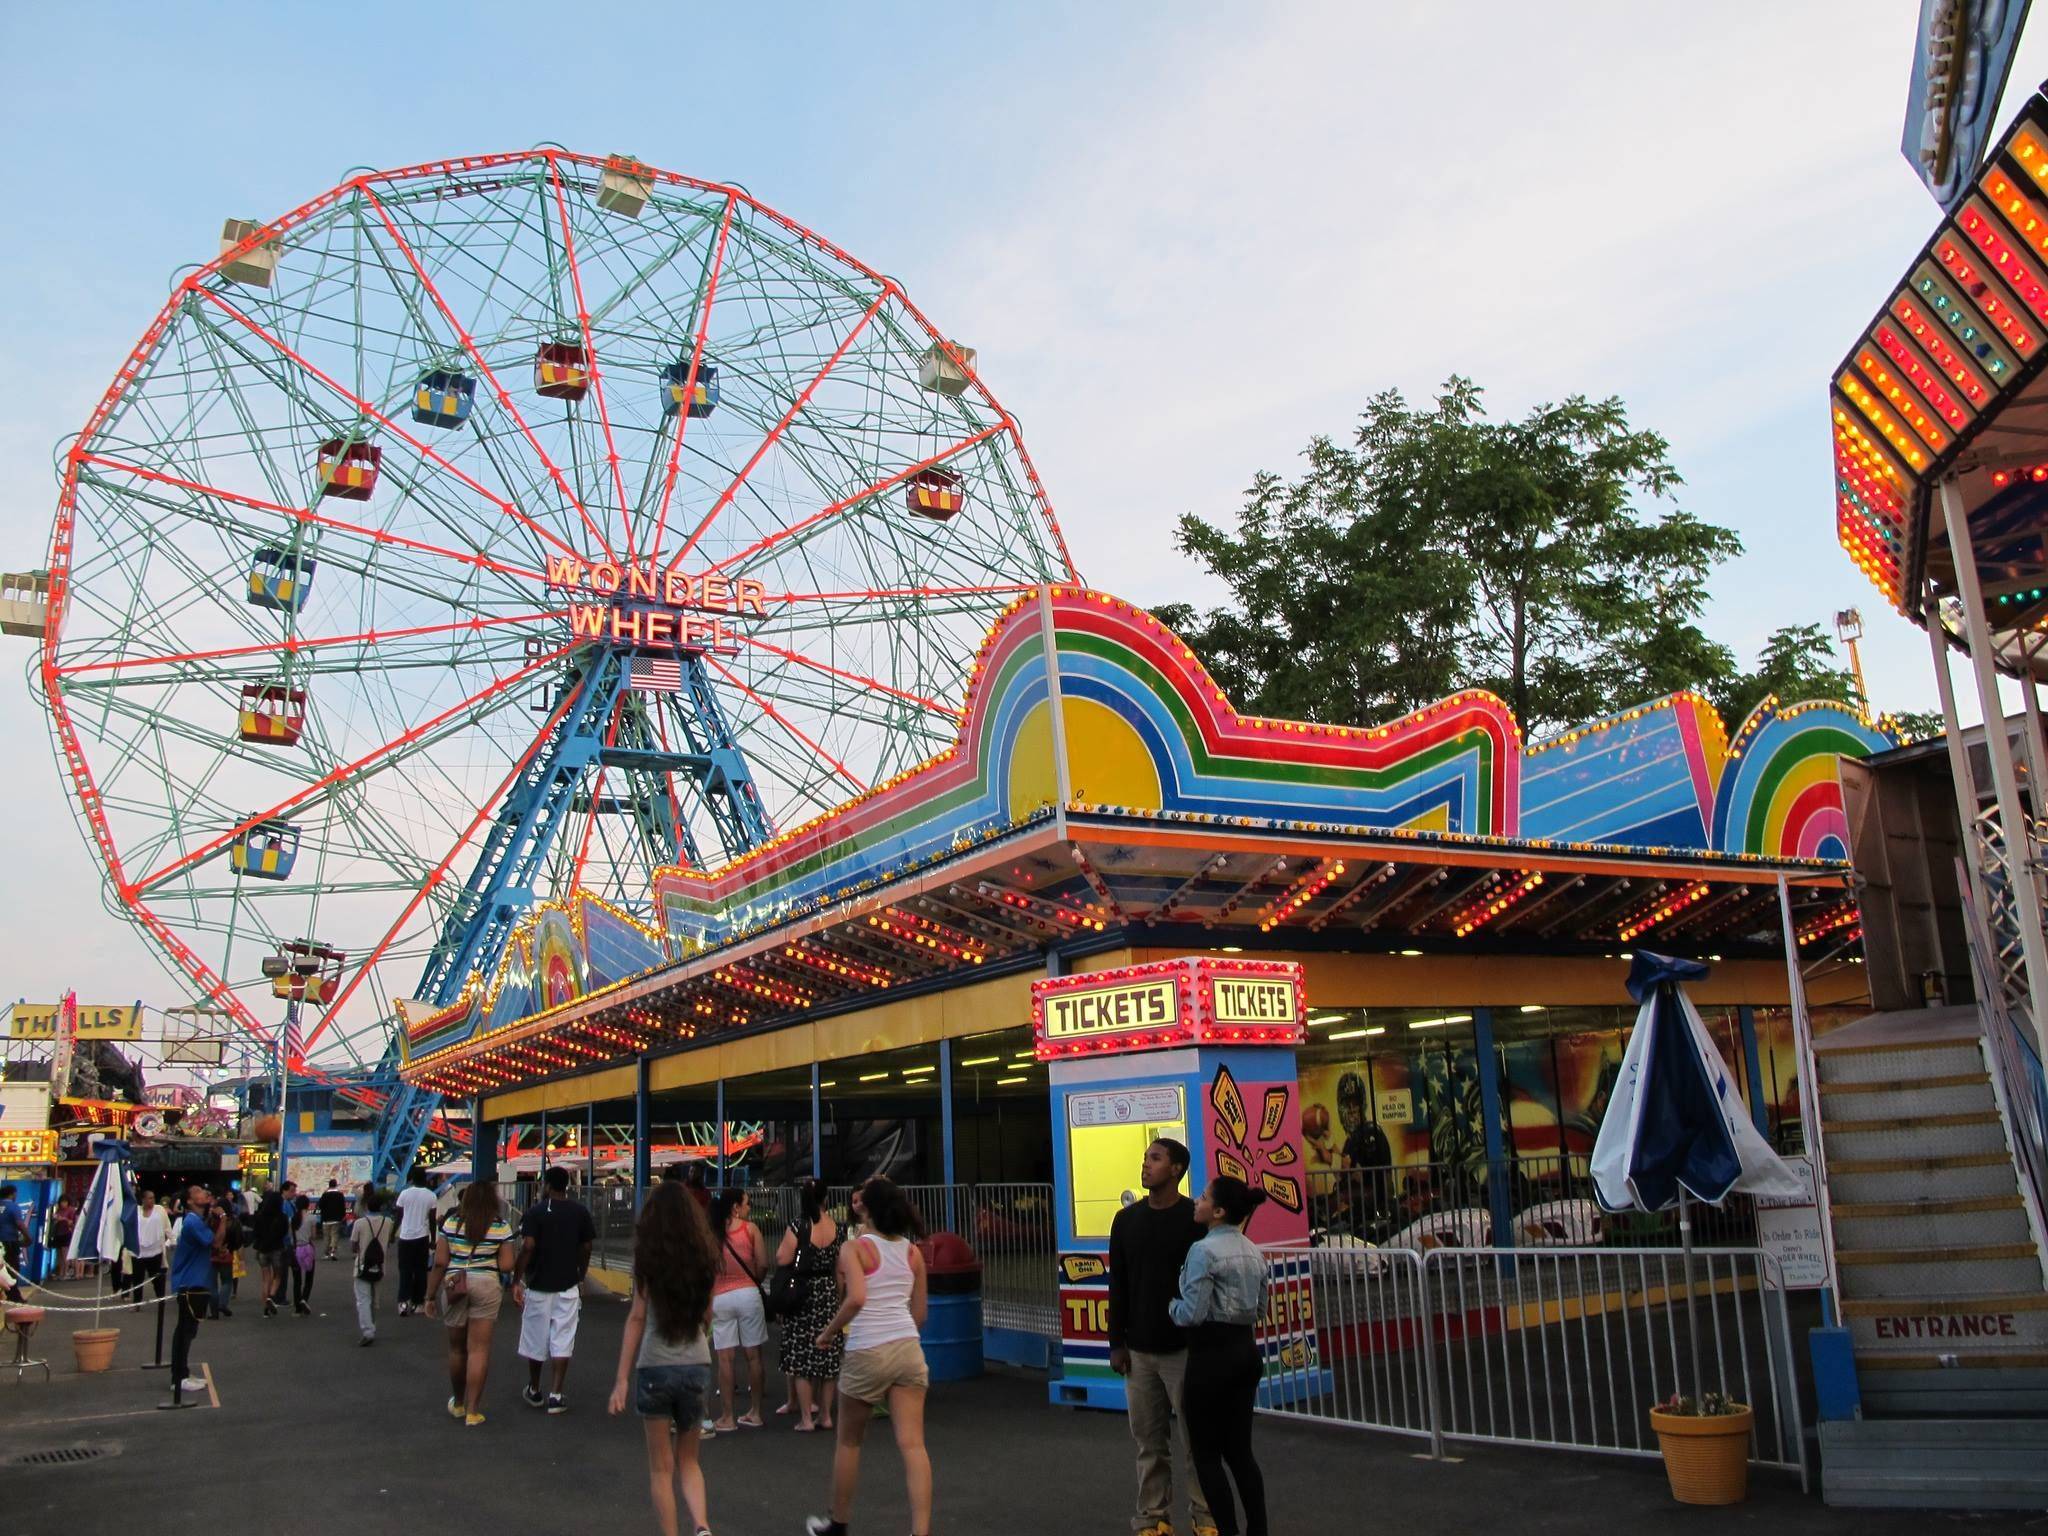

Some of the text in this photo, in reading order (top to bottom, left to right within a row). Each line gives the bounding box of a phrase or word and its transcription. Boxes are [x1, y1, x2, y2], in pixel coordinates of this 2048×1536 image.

[547, 555, 767, 616] WONDER
[570, 603, 741, 654] WHEEL
[1056, 988, 1164, 1032] TICKETS
[1221, 984, 1287, 1018] TICKETS
[1875, 1314, 2016, 1339] ENTRANCE
